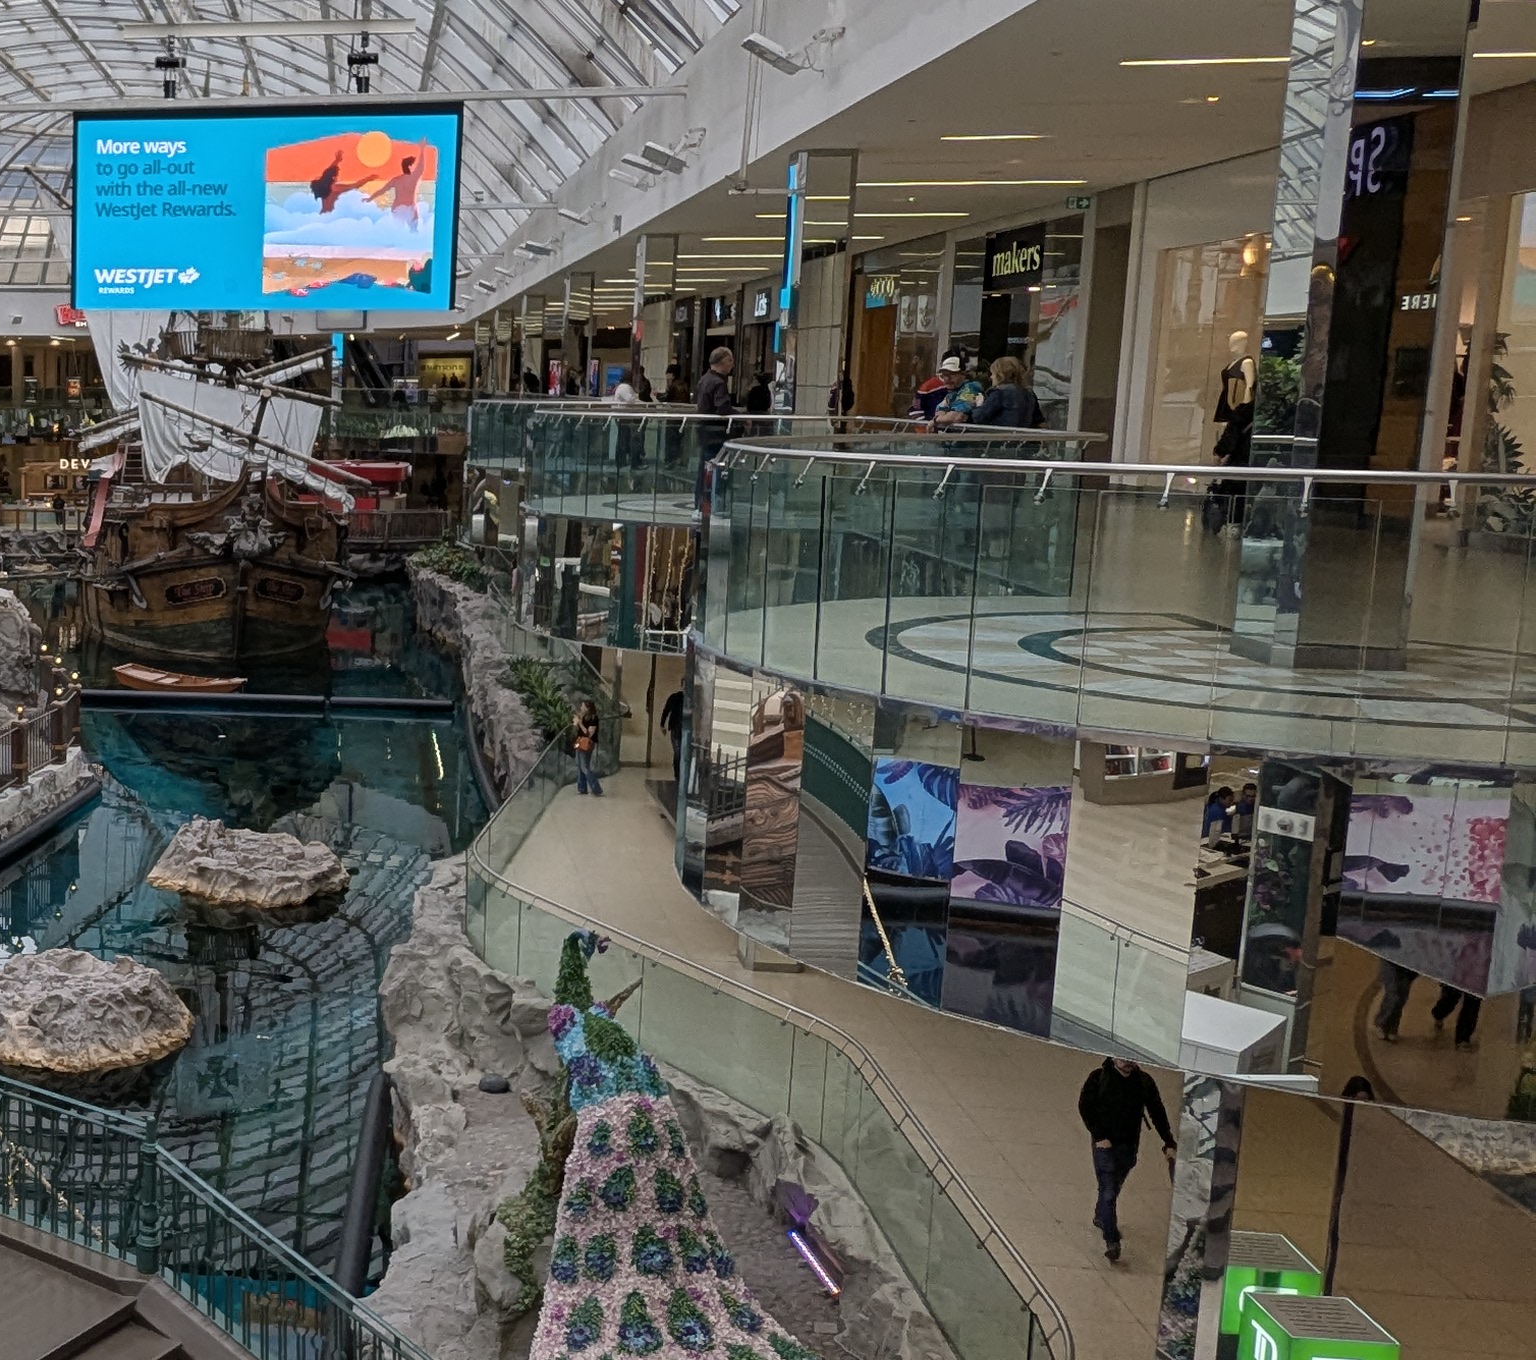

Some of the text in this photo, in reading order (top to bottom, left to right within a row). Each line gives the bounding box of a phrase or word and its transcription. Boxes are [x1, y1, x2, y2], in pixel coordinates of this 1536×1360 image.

[96, 140, 186, 157] More ways
[96, 160, 195, 179] to go all-out
[96, 180, 228, 196] with the all-new
[96, 201, 237, 220] WestJet Rewards.
[992, 241, 1041, 277] makers
[94, 269, 178, 288] WESTJET
